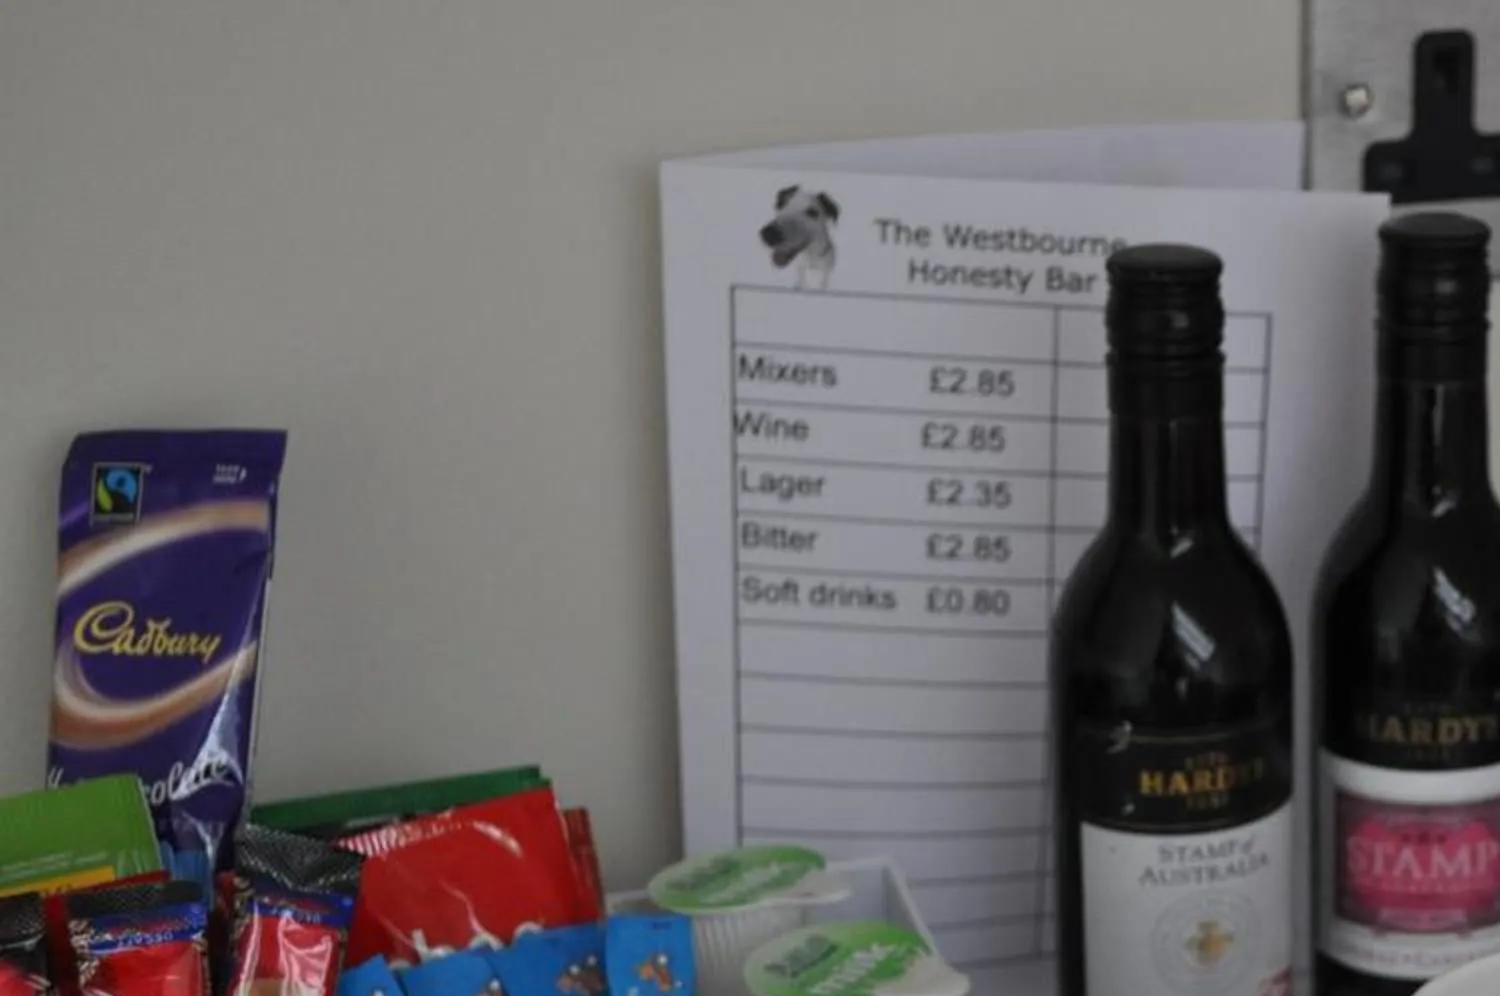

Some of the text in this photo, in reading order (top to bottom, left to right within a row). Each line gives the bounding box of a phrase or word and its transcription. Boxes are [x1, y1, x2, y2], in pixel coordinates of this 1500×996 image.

[874, 217, 1127, 256] The Westbourne
[907, 258, 1098, 296] Honesty Bar
[737, 352, 1016, 397] Mixers £2.85
[732, 410, 1006, 452] Wine £2.85
[740, 465, 1013, 510] Lager £2.35
[741, 520, 1013, 563] Bitter £2.85
[741, 575, 1012, 617] Soft drinks £0.80
[73, 600, 222, 665] Cadbury
[1156, 839, 1238, 865] STAMP
[1345, 834, 1500, 881] STAMP
